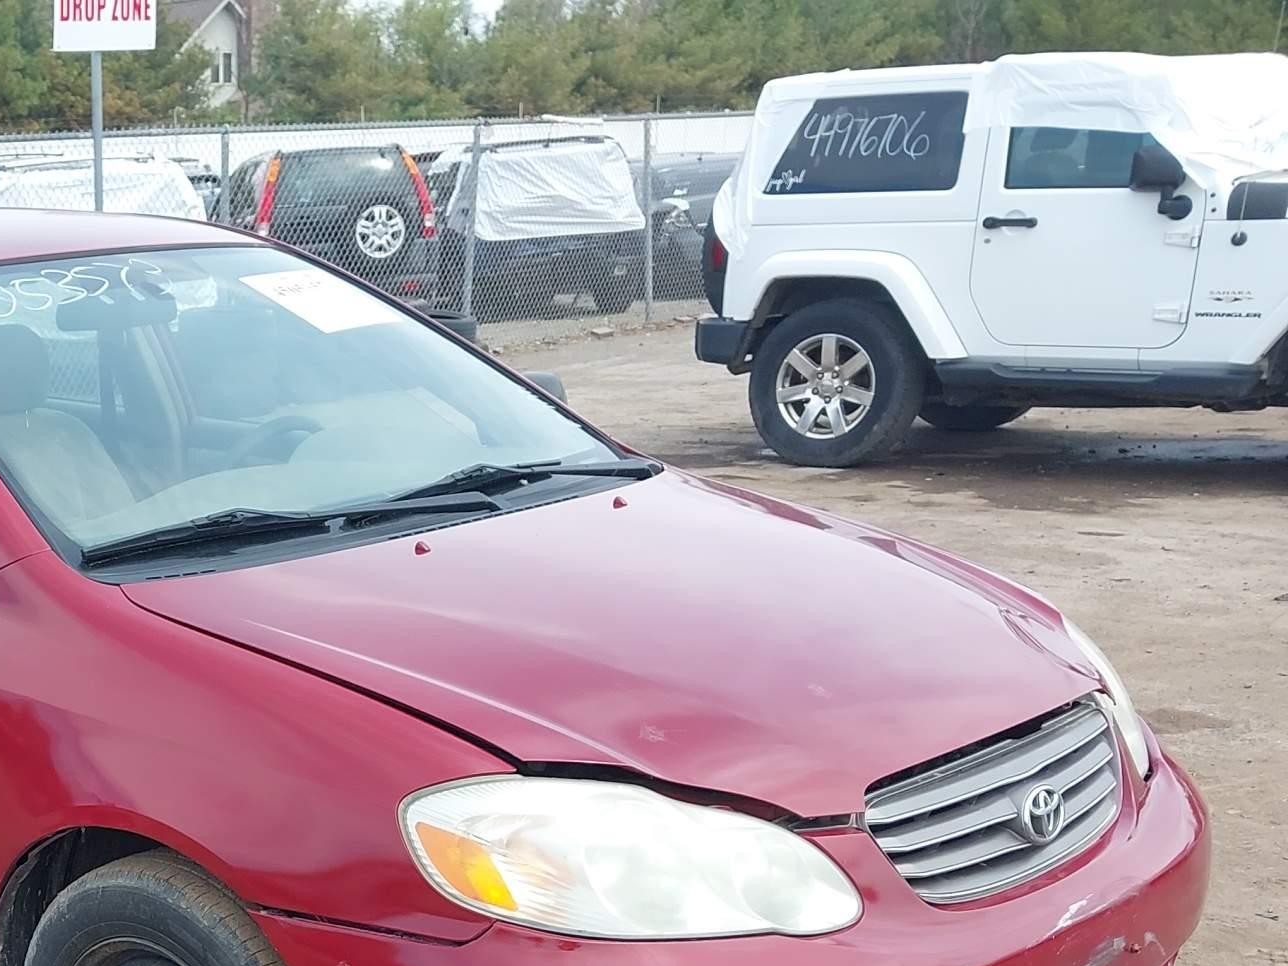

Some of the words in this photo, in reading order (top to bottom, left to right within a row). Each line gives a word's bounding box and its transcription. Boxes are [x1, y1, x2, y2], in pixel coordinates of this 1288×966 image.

[59, 0, 106, 22] DROP
[111, 0, 152, 22] ZONE
[803, 111, 931, 161] 44976706
[1195, 311, 1262, 319] WRANGLER
